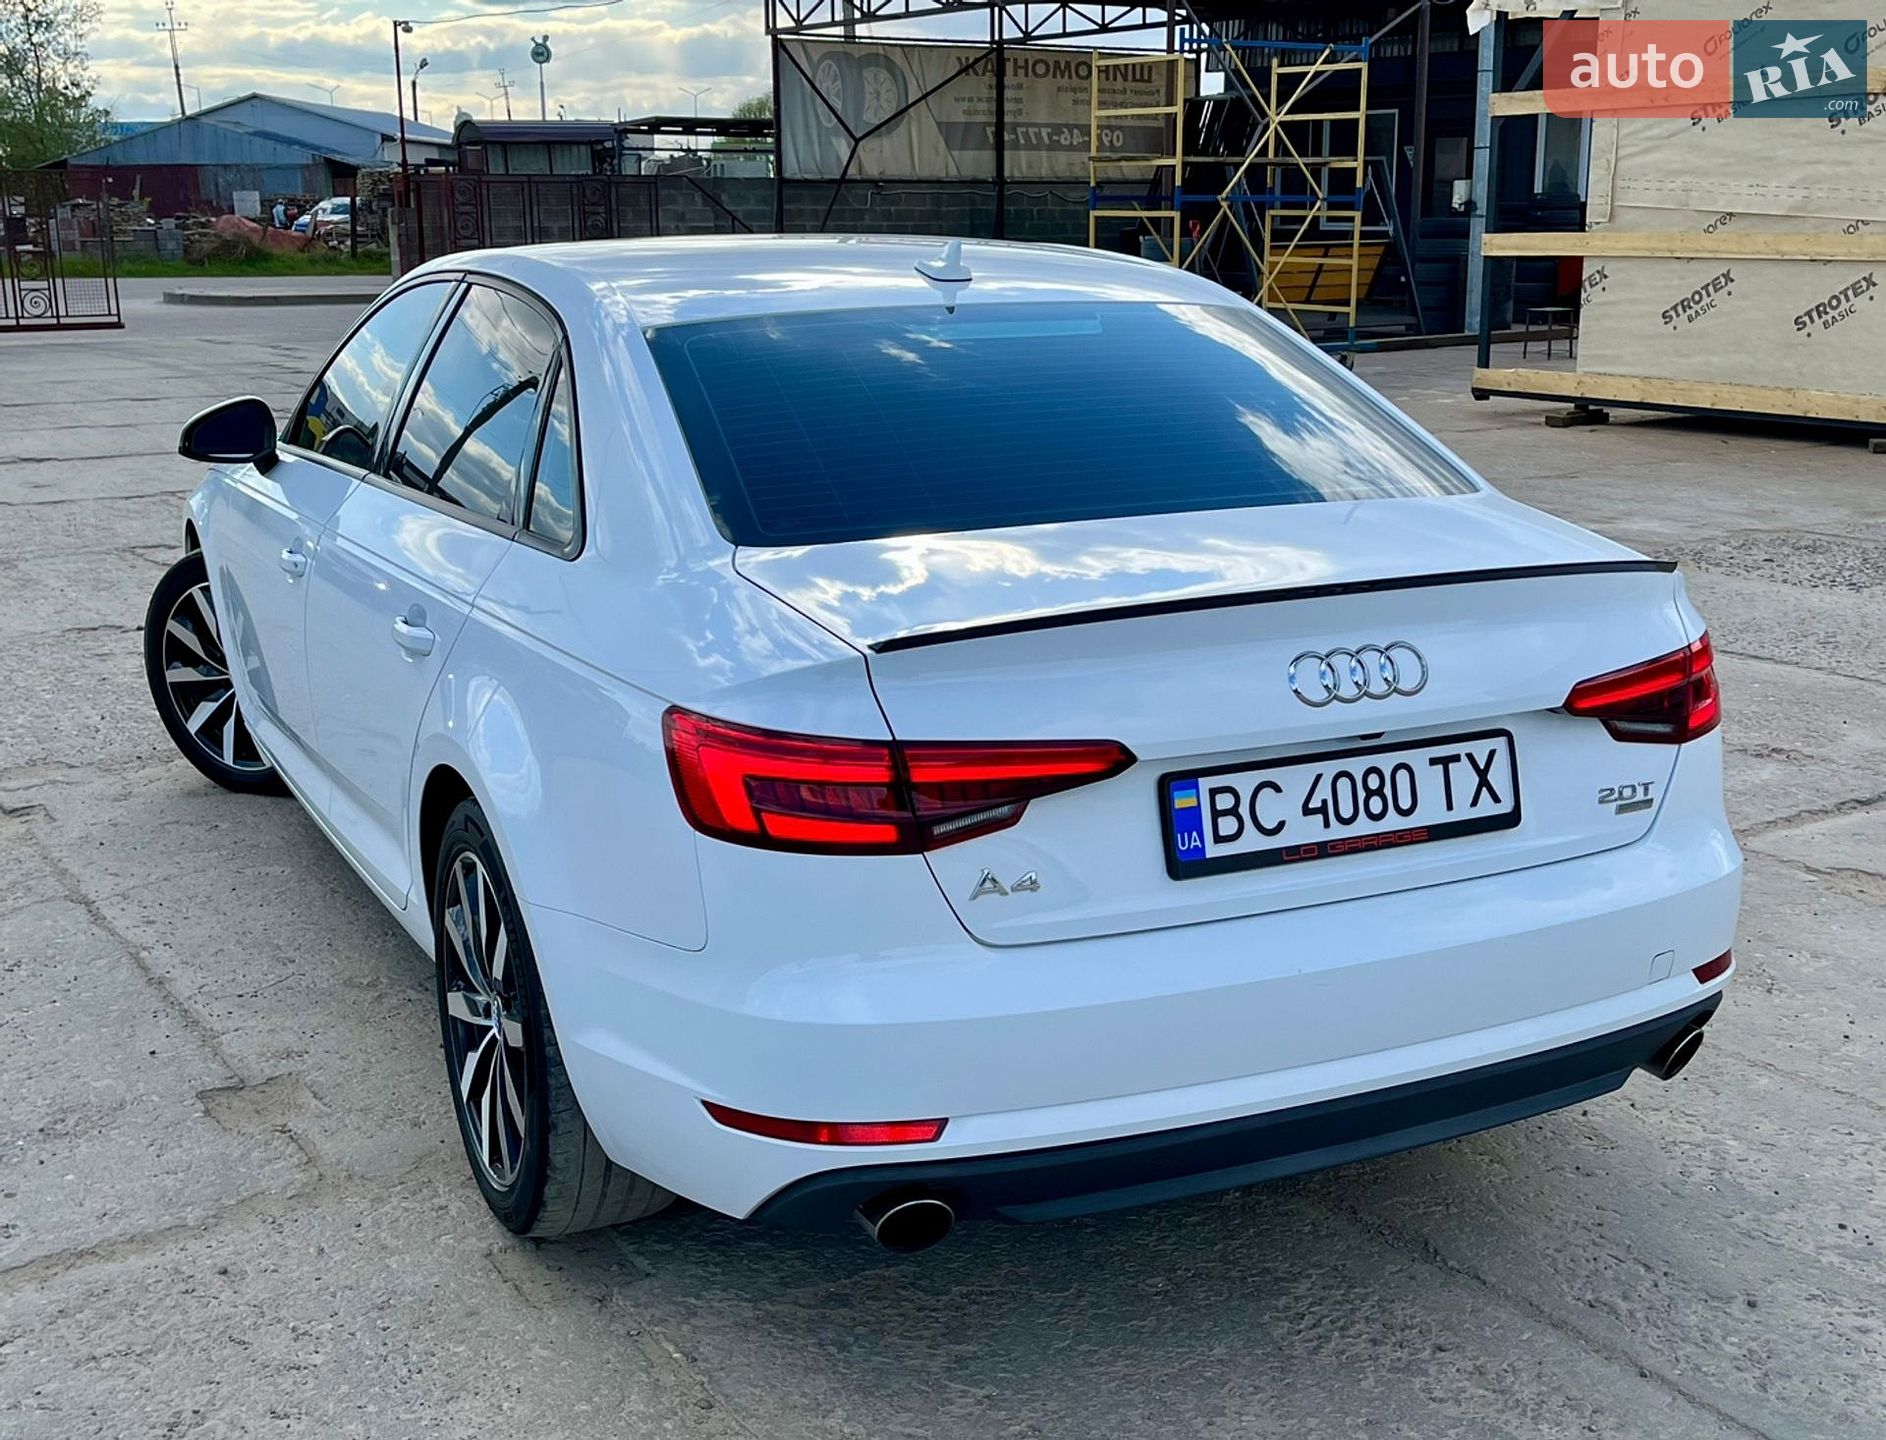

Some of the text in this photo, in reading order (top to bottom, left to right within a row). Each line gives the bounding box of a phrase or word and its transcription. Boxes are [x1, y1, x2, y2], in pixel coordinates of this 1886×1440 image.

[1661, 268, 1735, 325] STROTEX
[1686, 299, 1718, 324] BASIC
[1793, 272, 1878, 332] STROTEX
[1822, 304, 1857, 330] BASIC
[1208, 749, 1502, 845] BC 4080 TX
[1177, 830, 1202, 850] UA
[1282, 828, 1430, 861] LO GARAGE
[968, 867, 1041, 901] A4
